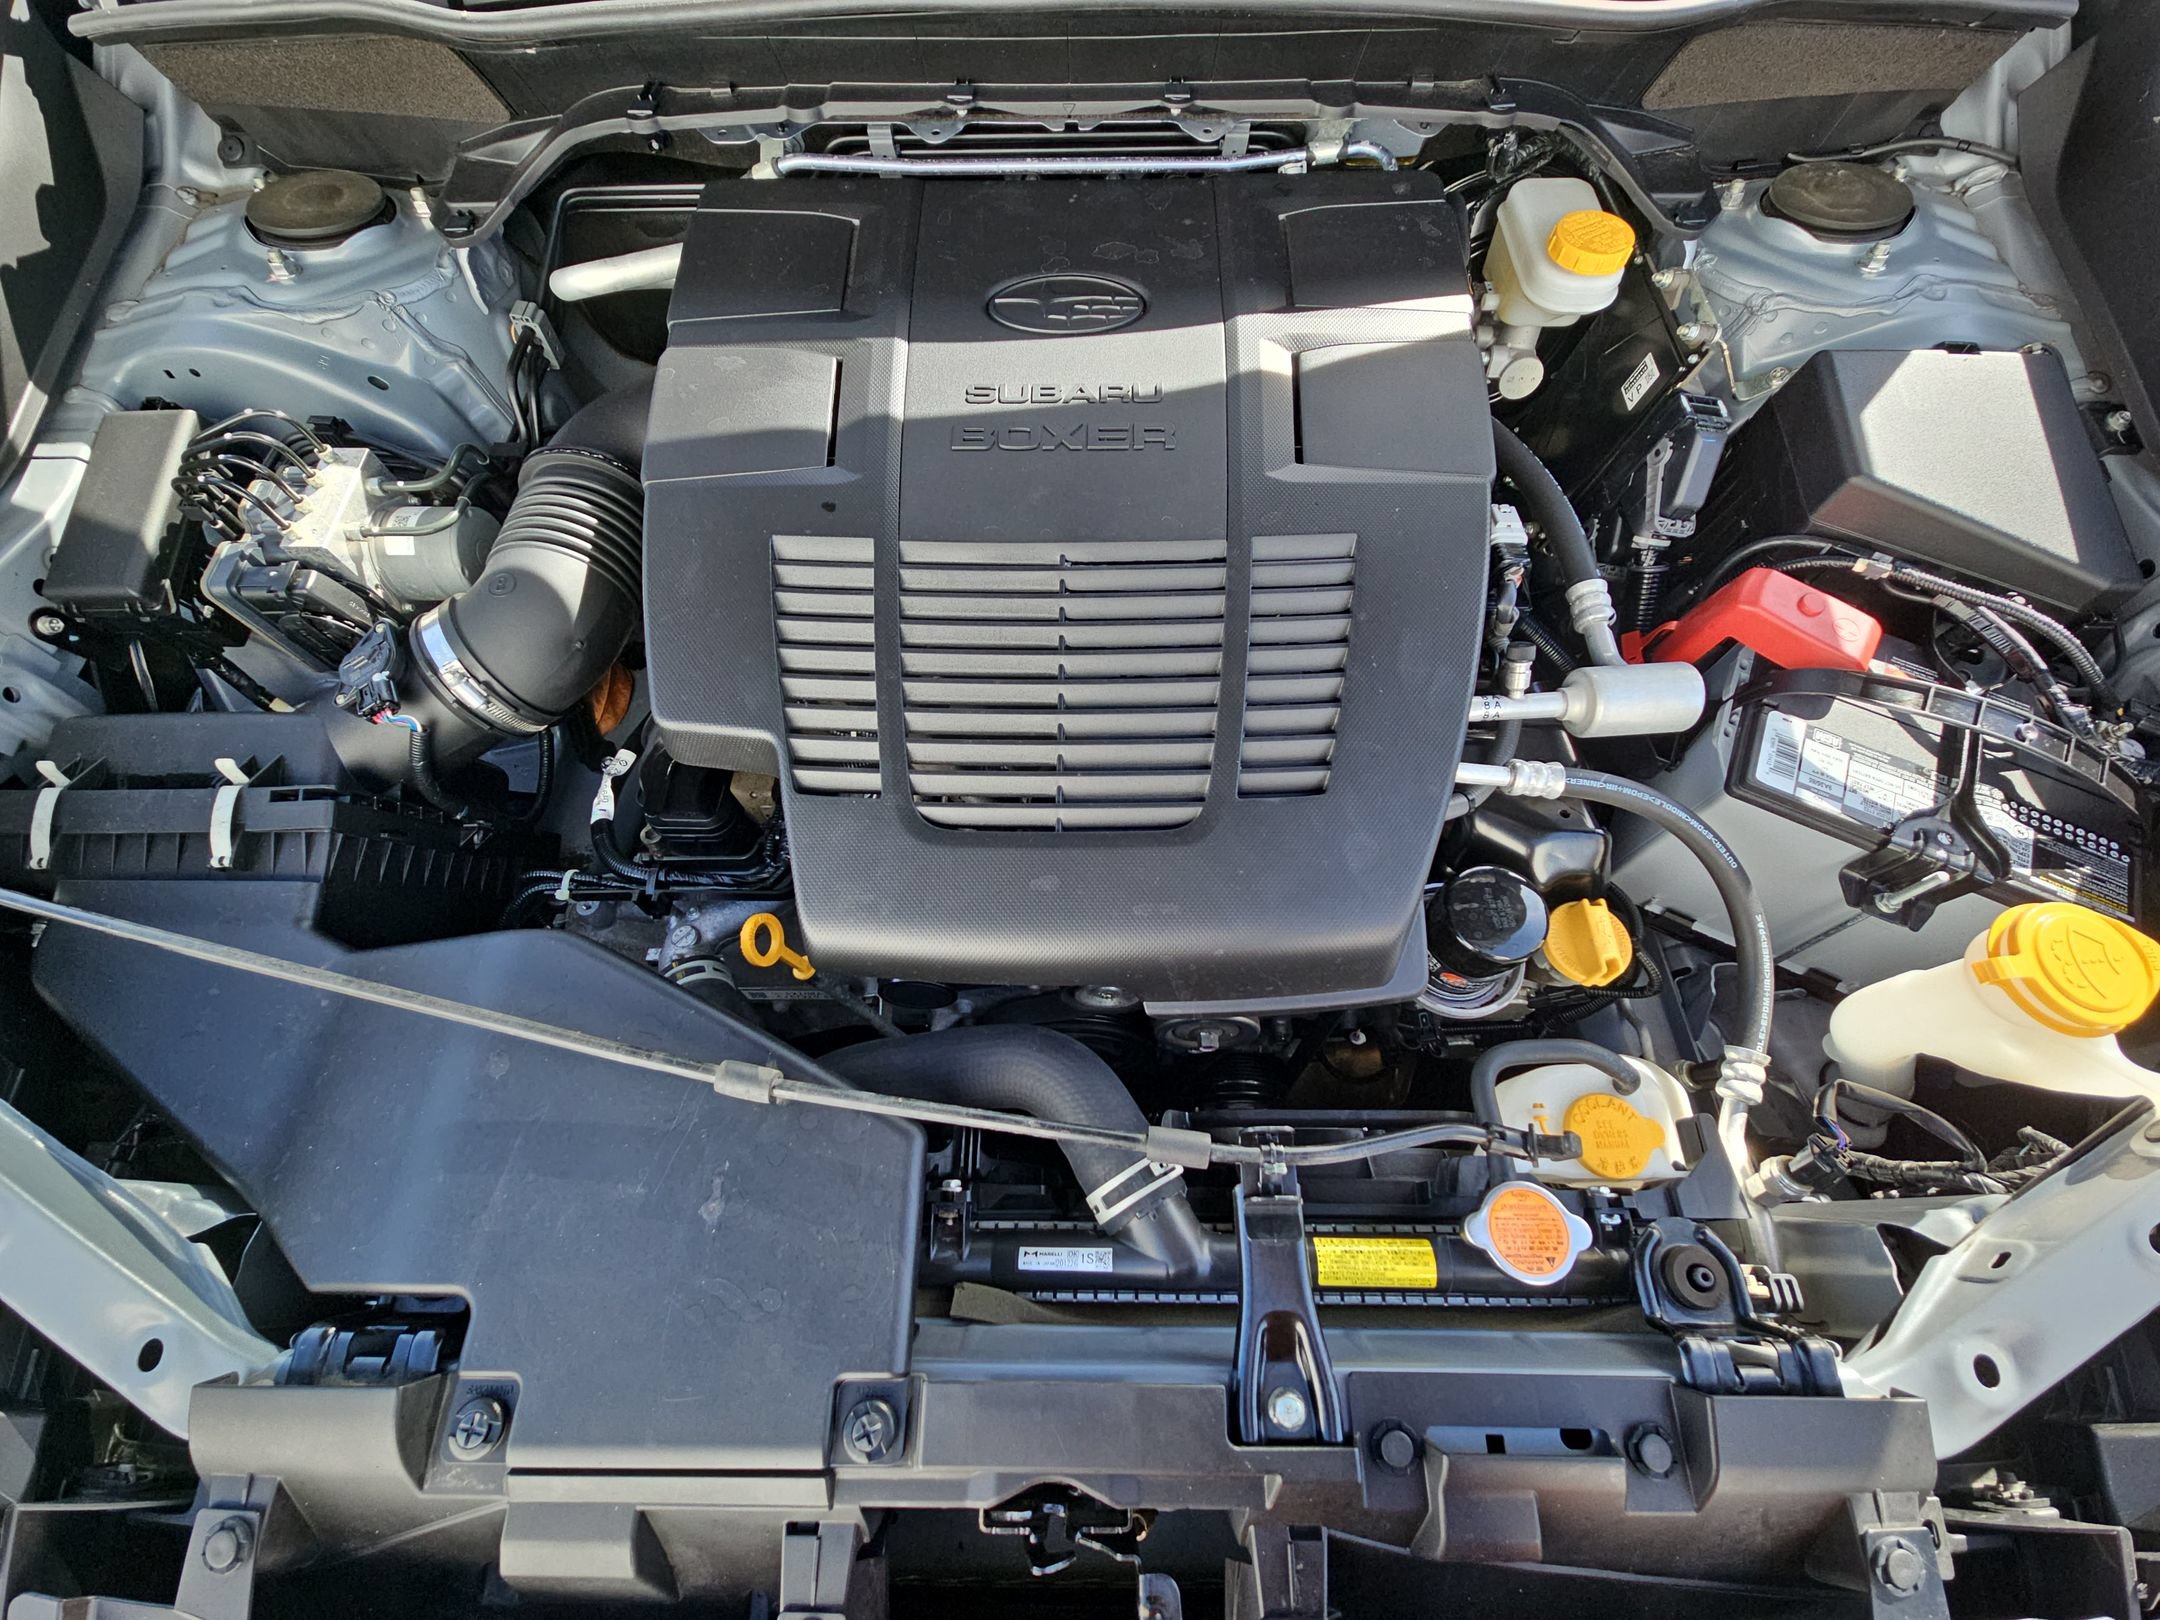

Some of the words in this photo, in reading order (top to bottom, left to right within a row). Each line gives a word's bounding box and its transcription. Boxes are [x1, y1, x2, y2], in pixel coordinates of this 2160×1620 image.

[965, 383, 1164, 404] SUBARU
[951, 423, 1176, 452] BOXER
[1573, 1098, 1638, 1123] COOLANT
